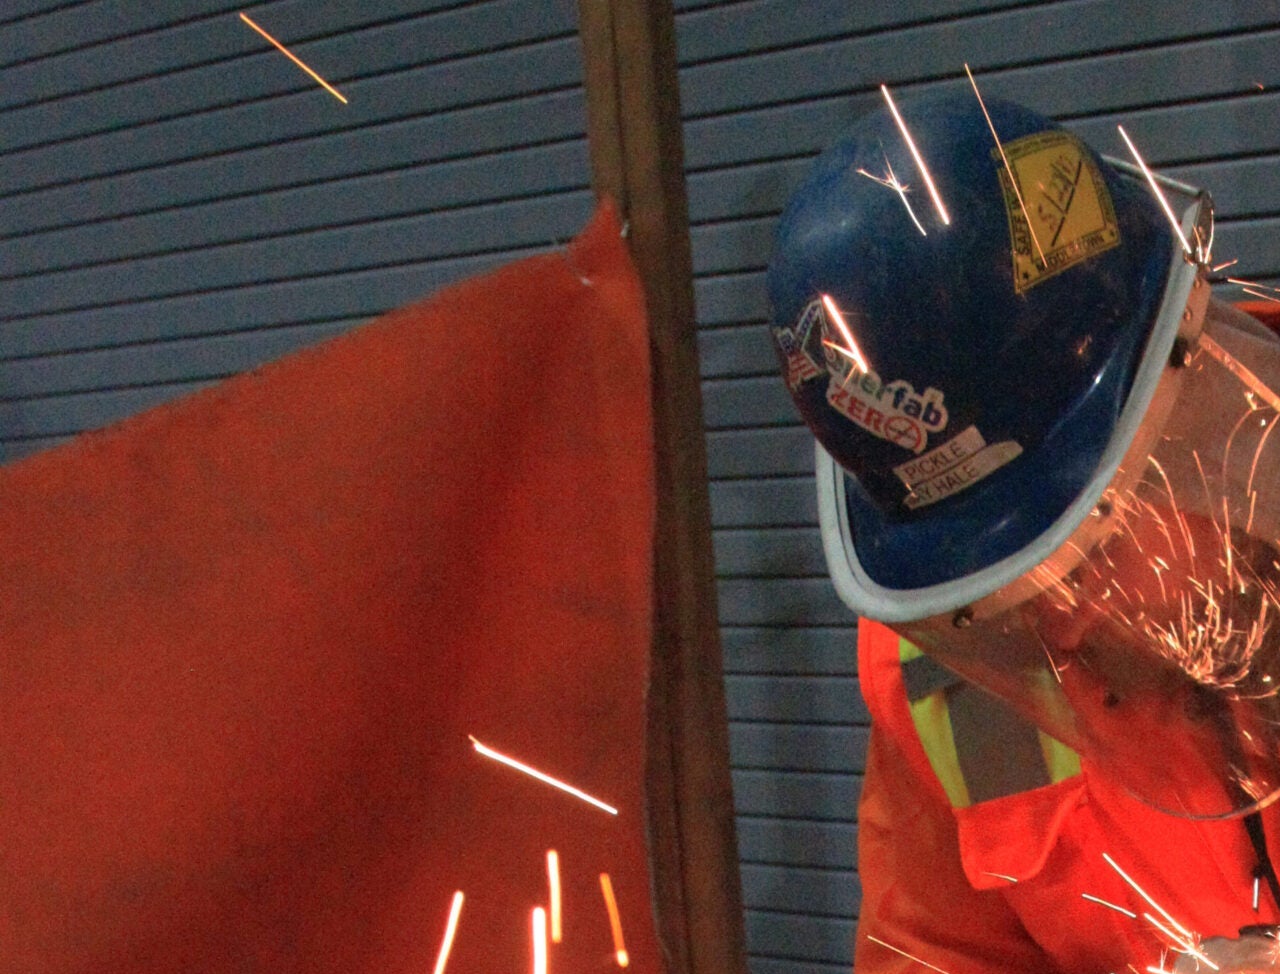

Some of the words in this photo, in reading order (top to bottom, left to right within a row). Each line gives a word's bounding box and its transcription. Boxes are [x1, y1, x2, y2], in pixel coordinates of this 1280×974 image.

[1035, 234, 1104, 273] MDDLETOWN
[904, 441, 963, 479] PICKLE
[935, 465, 980, 495] HALE
